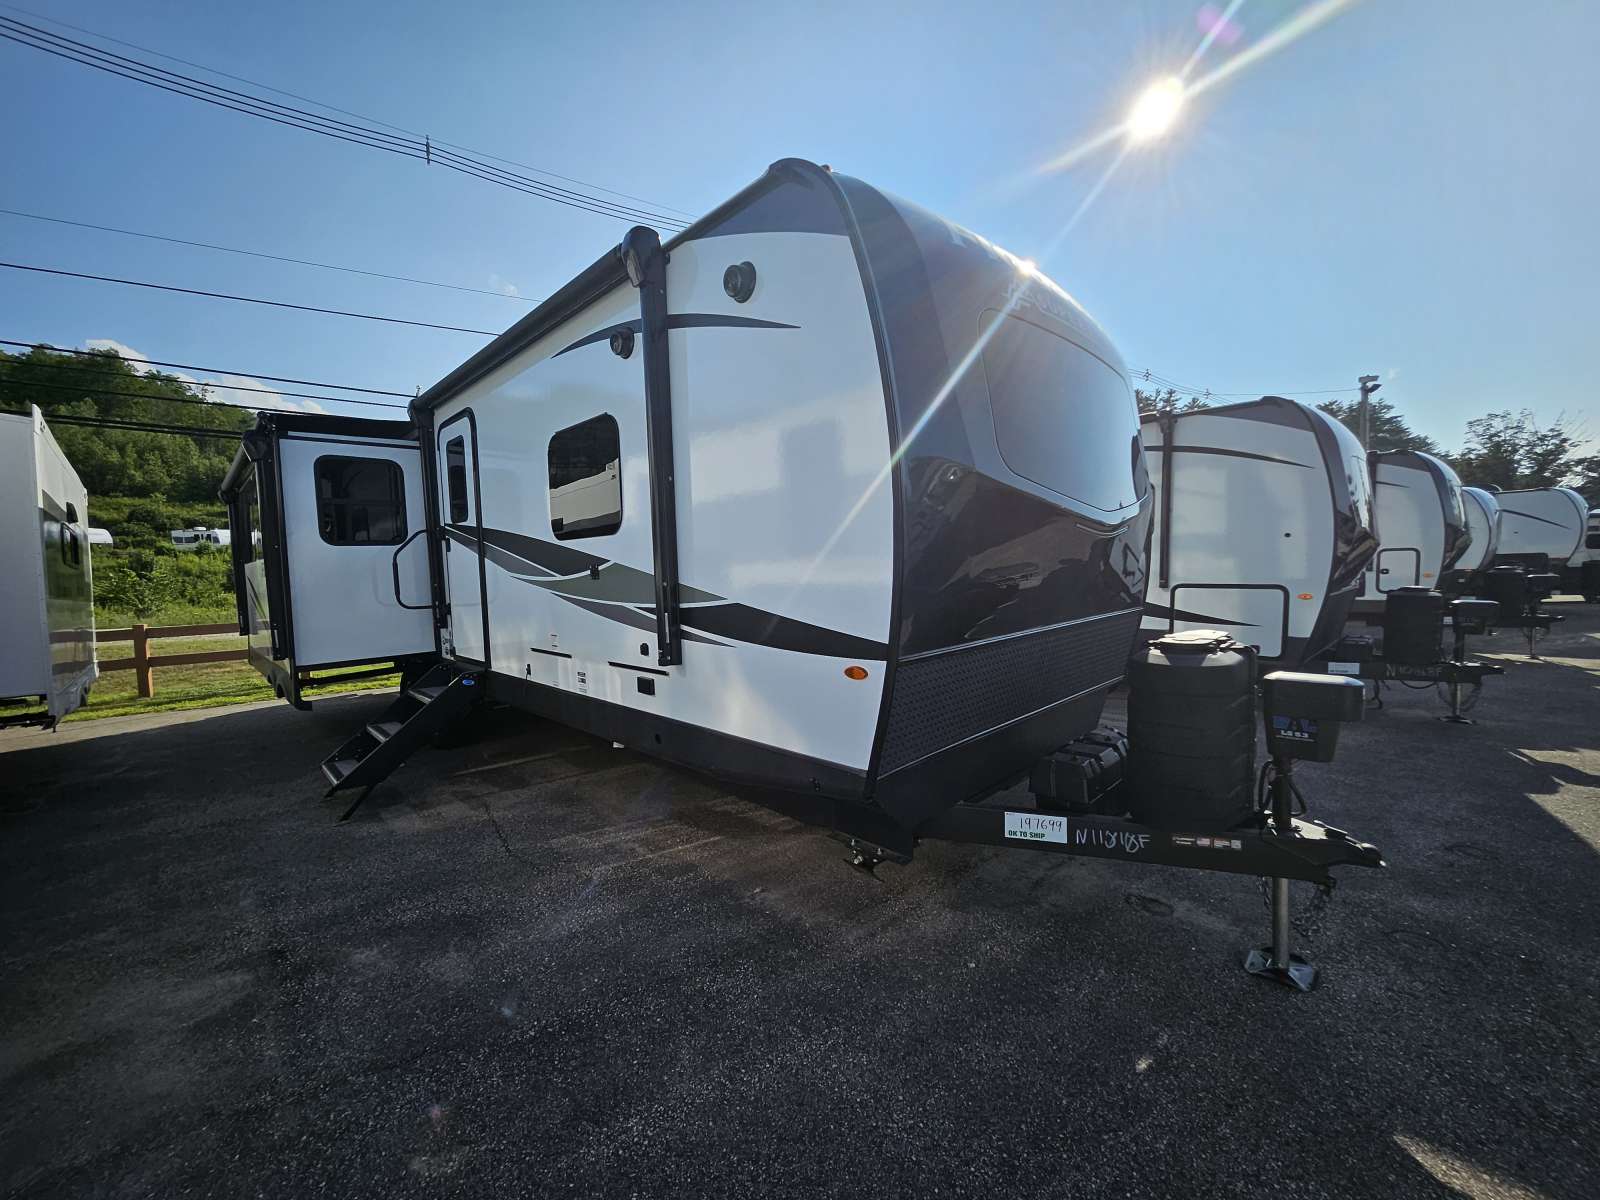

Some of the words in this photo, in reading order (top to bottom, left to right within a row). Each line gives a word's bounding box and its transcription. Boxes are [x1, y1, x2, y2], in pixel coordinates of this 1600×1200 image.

[1020, 817, 1063, 832] 197699
[1008, 829, 1018, 837] OK
[1029, 831, 1046, 839] SHIP
